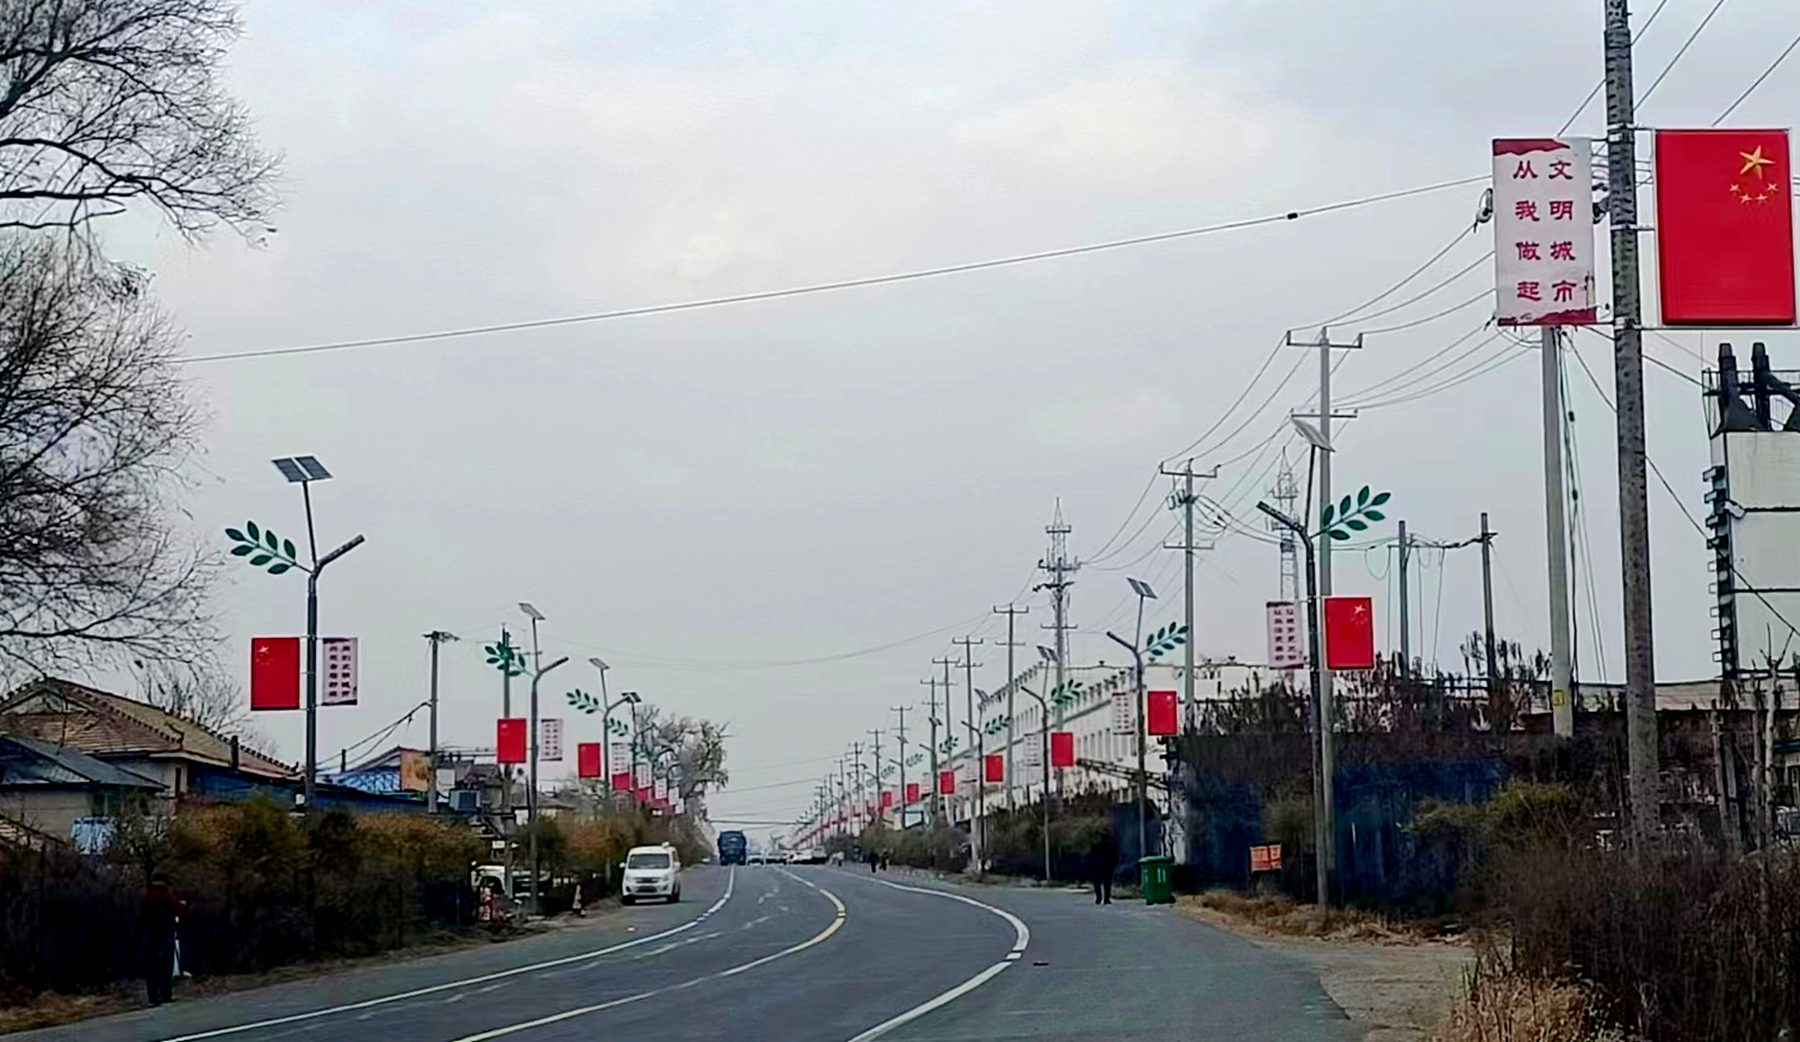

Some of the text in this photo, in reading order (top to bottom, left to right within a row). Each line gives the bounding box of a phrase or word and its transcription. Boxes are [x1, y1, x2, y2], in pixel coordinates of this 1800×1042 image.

[1513, 160, 1542, 302] 从我做起
[1548, 160, 1577, 303] 文明城市
